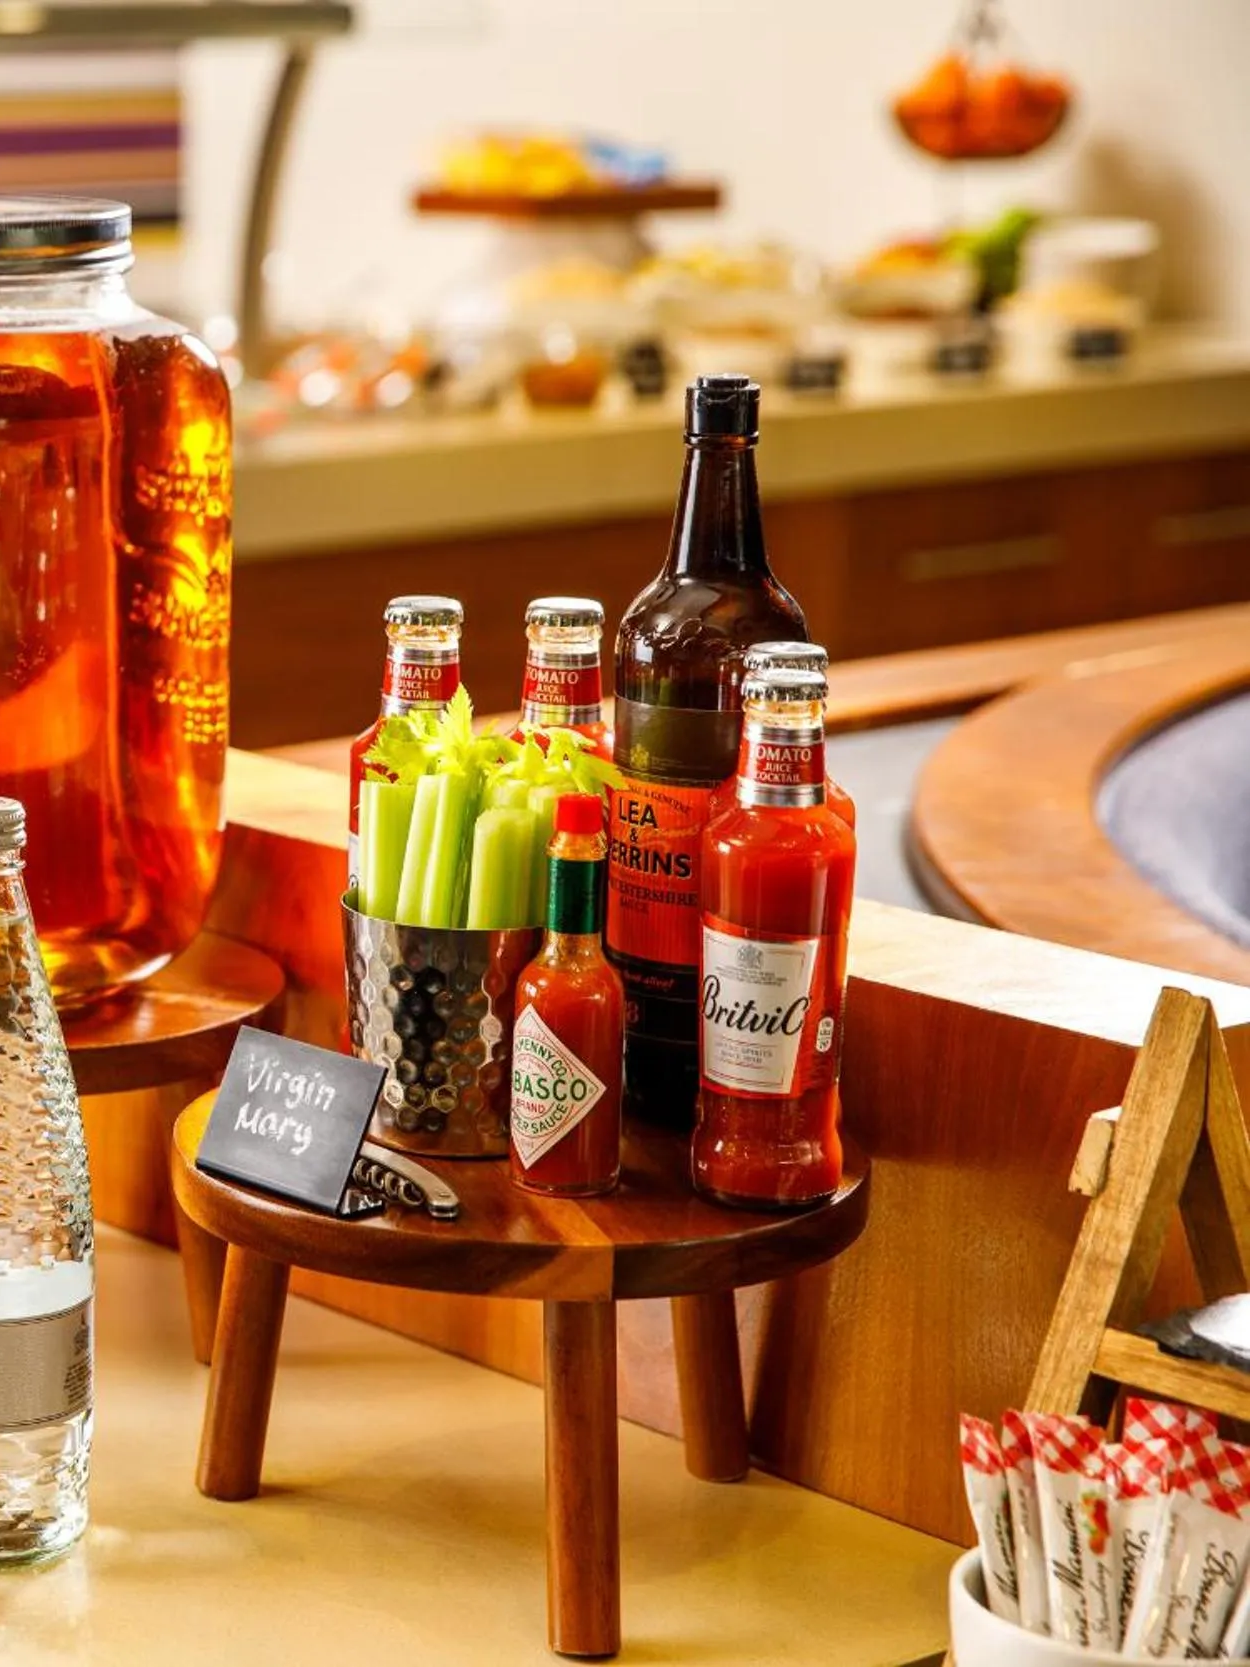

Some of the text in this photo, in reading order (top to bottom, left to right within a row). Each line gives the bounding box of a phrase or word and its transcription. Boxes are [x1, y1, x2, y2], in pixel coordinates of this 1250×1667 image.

[387, 661, 442, 681] TMATO
[526, 665, 579, 685] TOMATO
[756, 745, 812, 764] OMATO
[764, 761, 792, 773] JUICE
[618, 796, 659, 829] LEA
[629, 827, 639, 842] &
[611, 837, 692, 879] ERRINS
[245, 1052, 337, 1111] Virgin
[513, 1069, 588, 1103] BASCO
[233, 1101, 314, 1156] Mary
[530, 1103, 569, 1134] SAUCE
